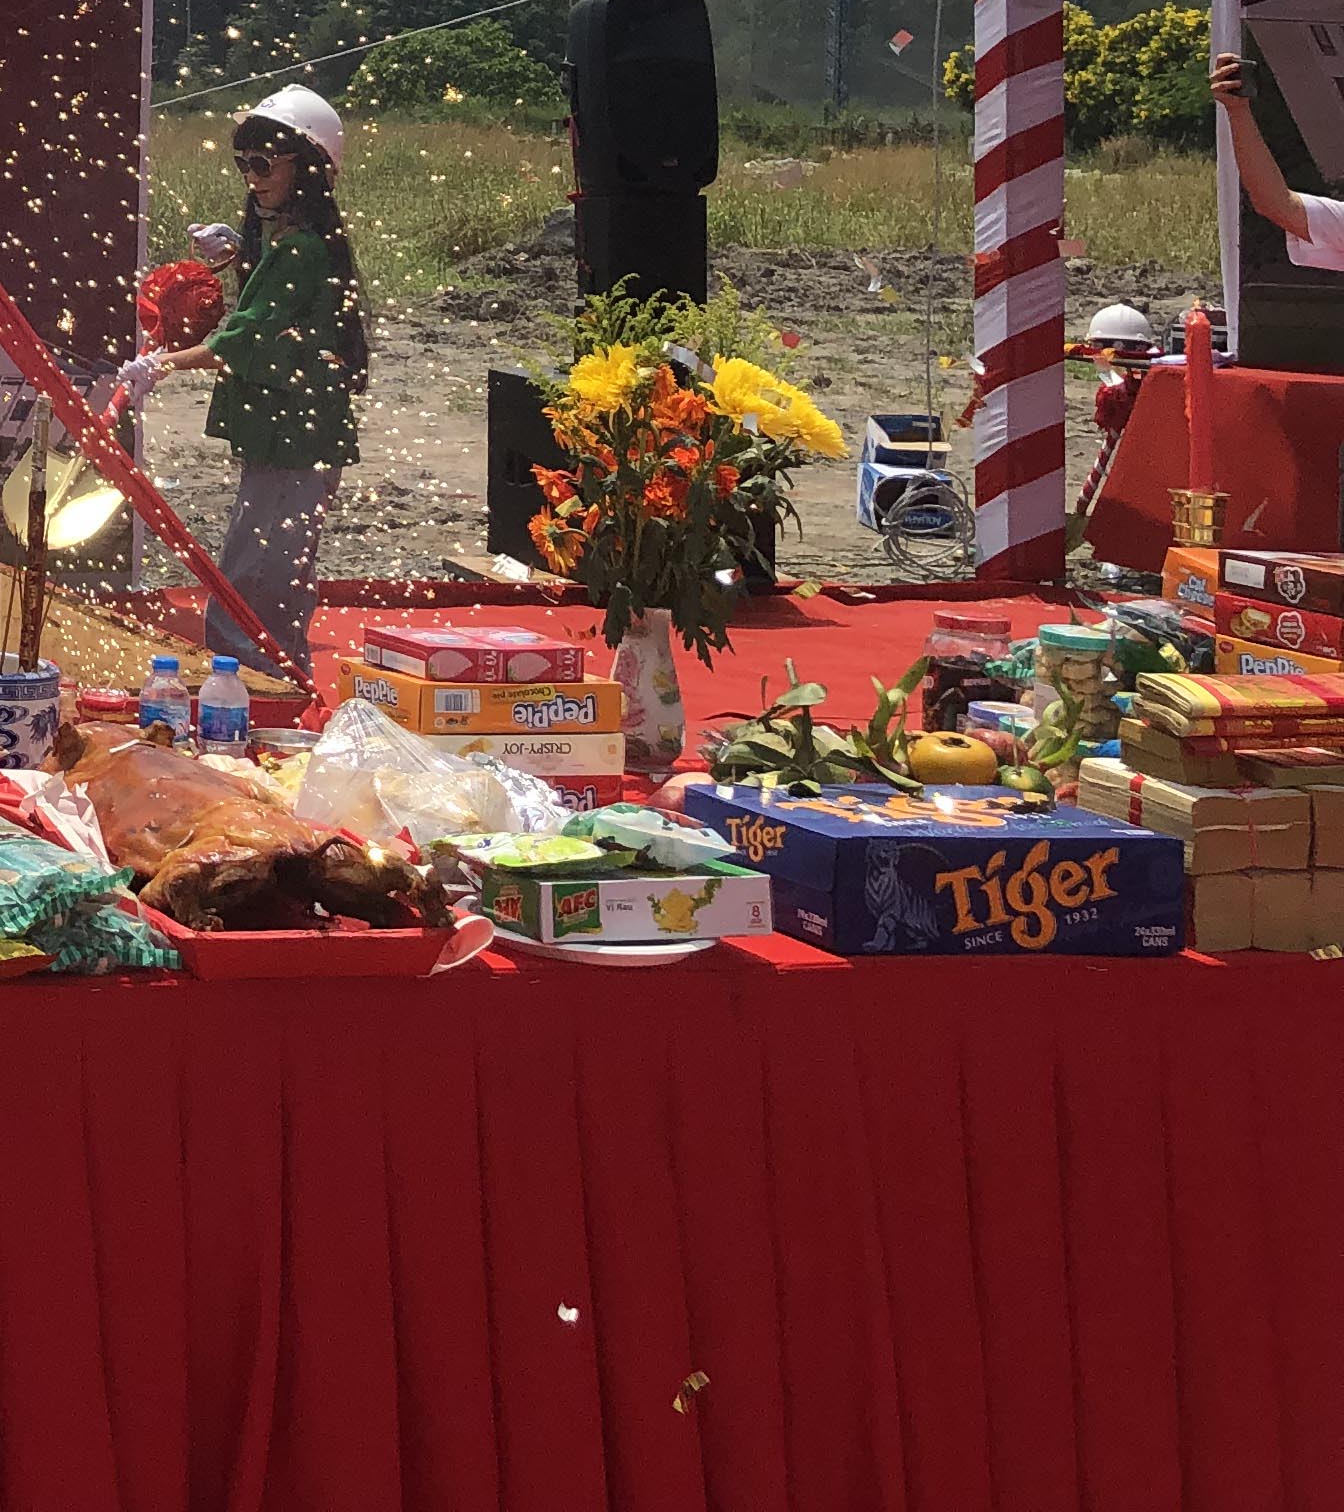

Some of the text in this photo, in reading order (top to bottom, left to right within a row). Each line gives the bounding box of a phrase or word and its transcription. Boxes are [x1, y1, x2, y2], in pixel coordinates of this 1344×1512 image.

[354, 674, 400, 707] PepPie
[514, 695, 598, 731] PepPie
[502, 741, 573, 756] CRISPY-JOY
[725, 815, 786, 863] Tiger
[559, 889, 597, 916] AFC
[751, 905, 761, 918] 8
[934, 840, 1120, 950] Tiger
[964, 907, 1099, 950] SINCE 1932
[1142, 936, 1169, 947] CANS
